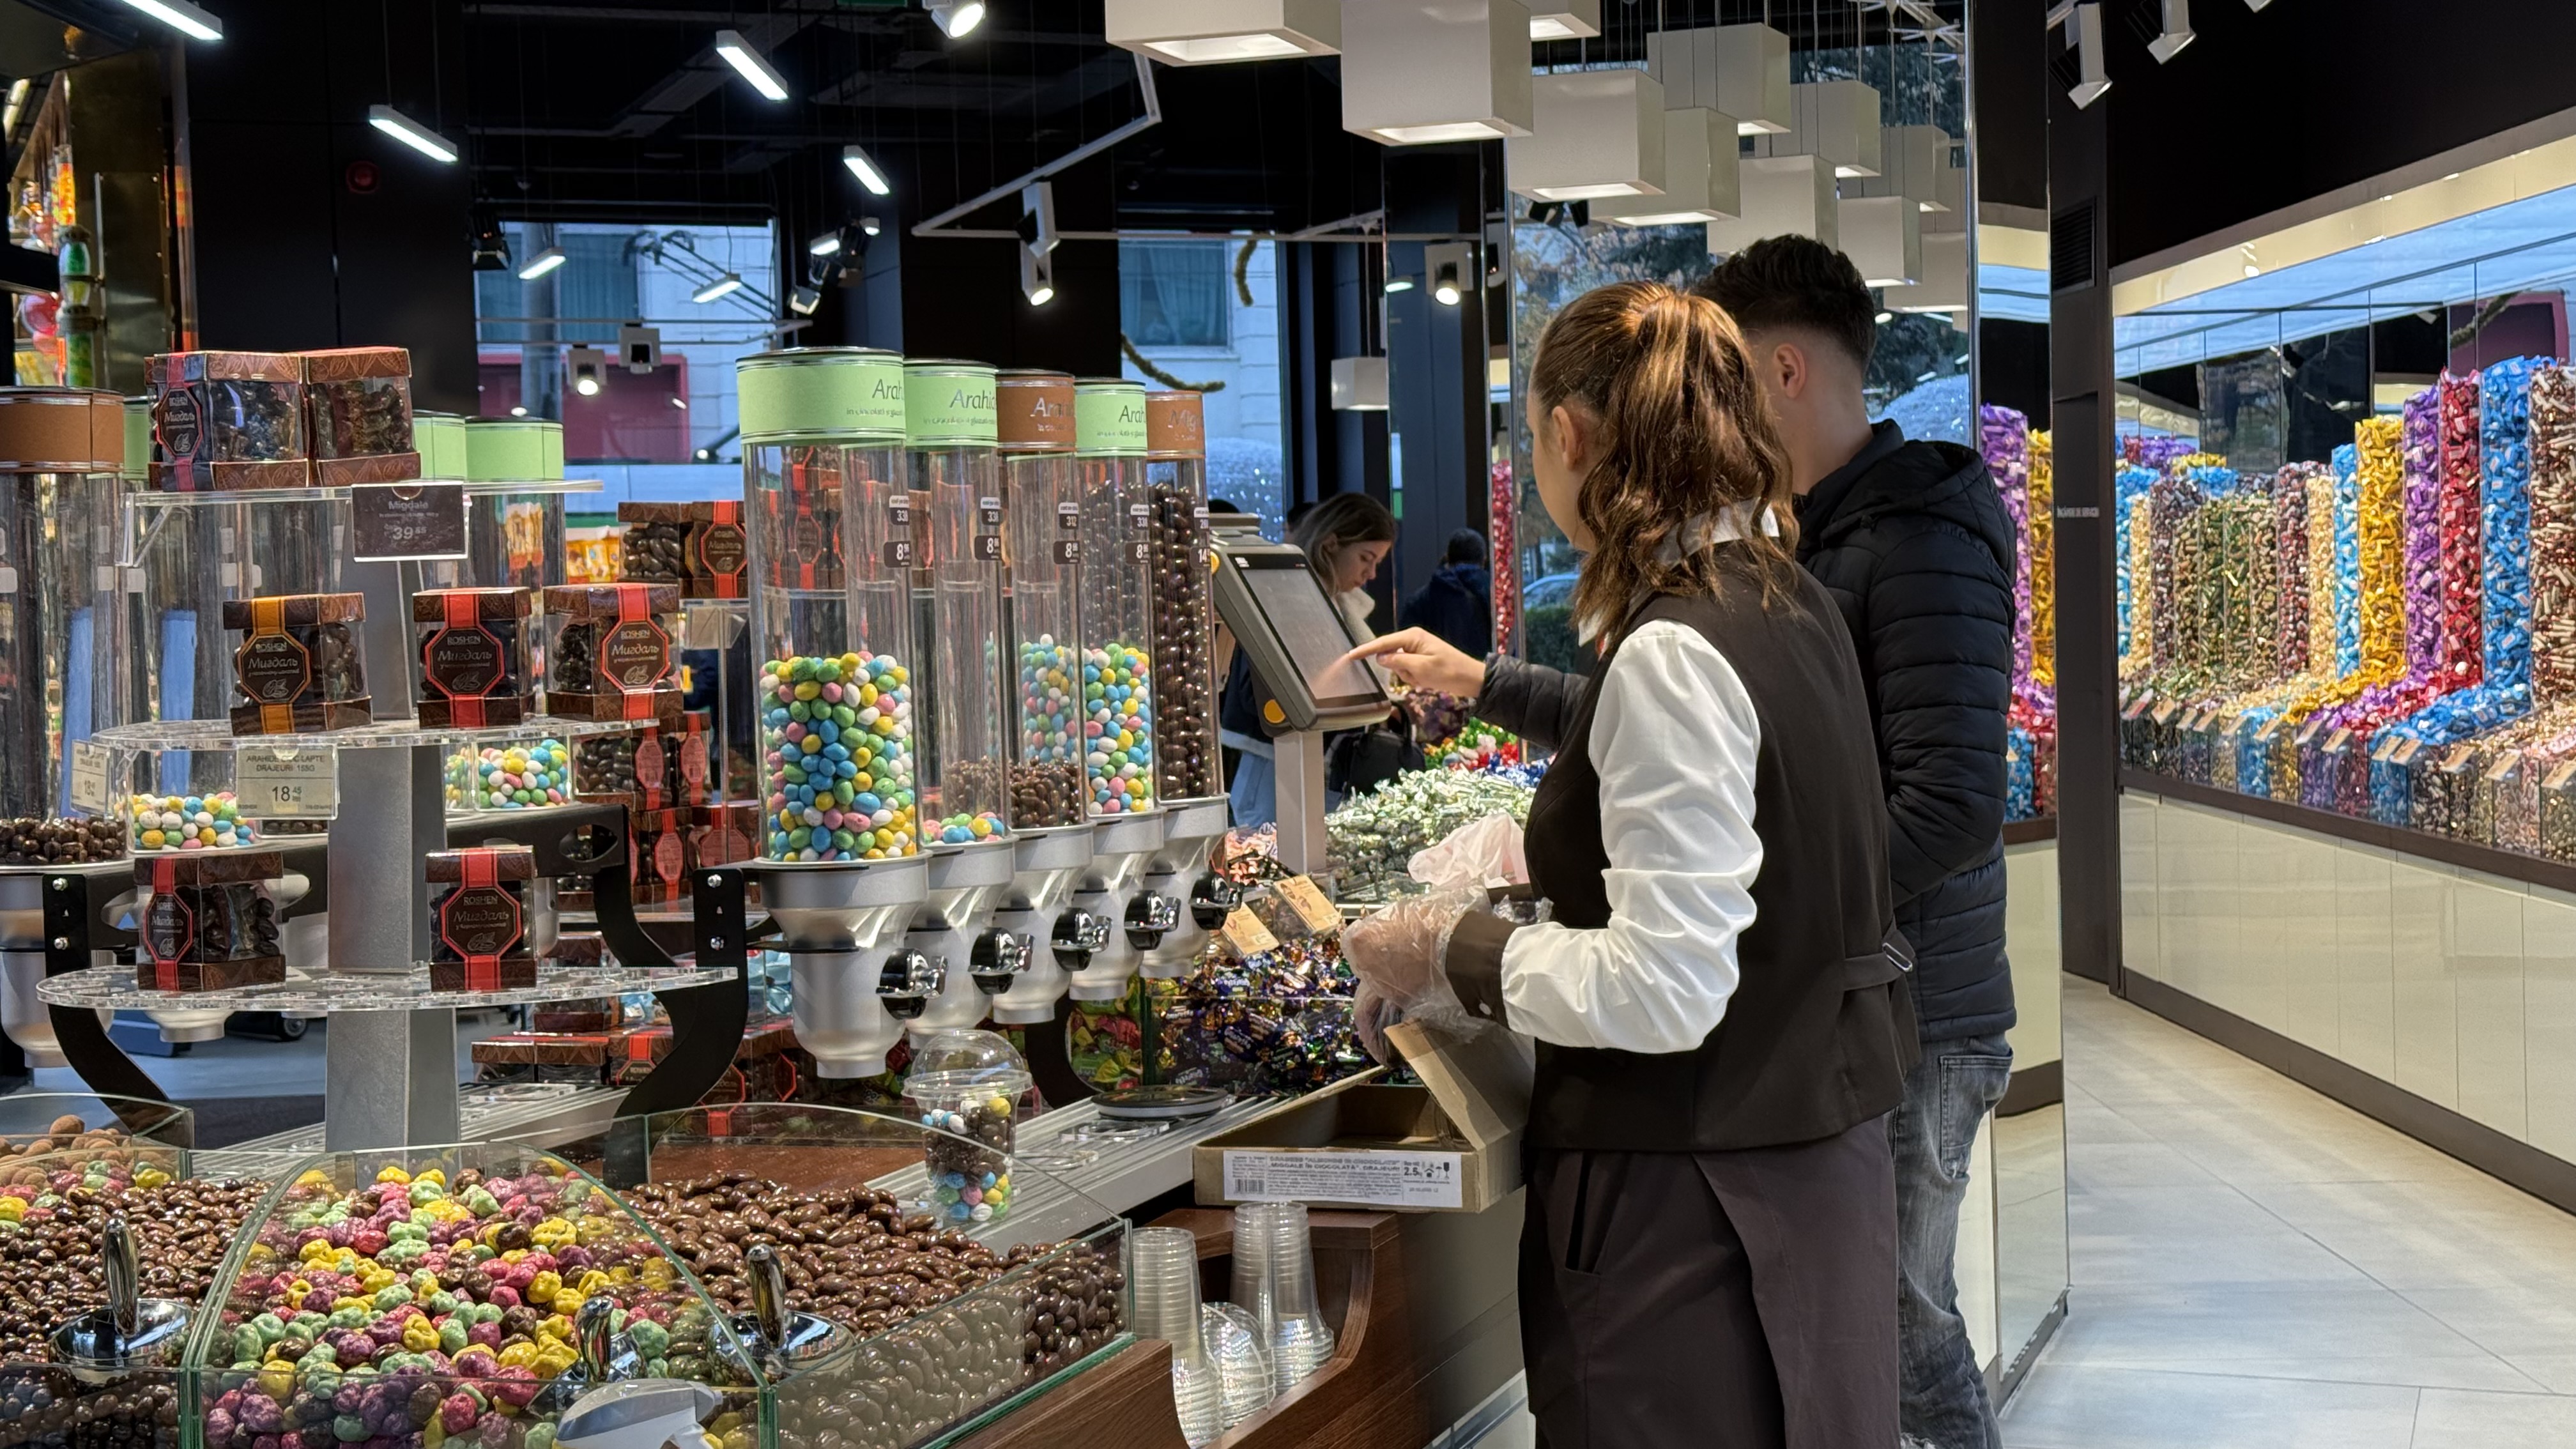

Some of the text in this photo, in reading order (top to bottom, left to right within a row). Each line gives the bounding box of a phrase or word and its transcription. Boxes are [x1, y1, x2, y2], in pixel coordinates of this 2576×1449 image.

[388, 501, 429, 512] Migdale
[392, 526, 413, 540] 39
[896, 543, 904, 561] 8
[986, 537, 994, 554] 8
[1065, 542, 1073, 558] 8
[1136, 544, 1144, 559] 8
[448, 636, 481, 645] ROSHEN
[248, 656, 298, 669] Мигдаль
[272, 785, 291, 802] 18
[463, 895, 498, 906] ROSHEN
[454, 910, 509, 922] Мигдаль
